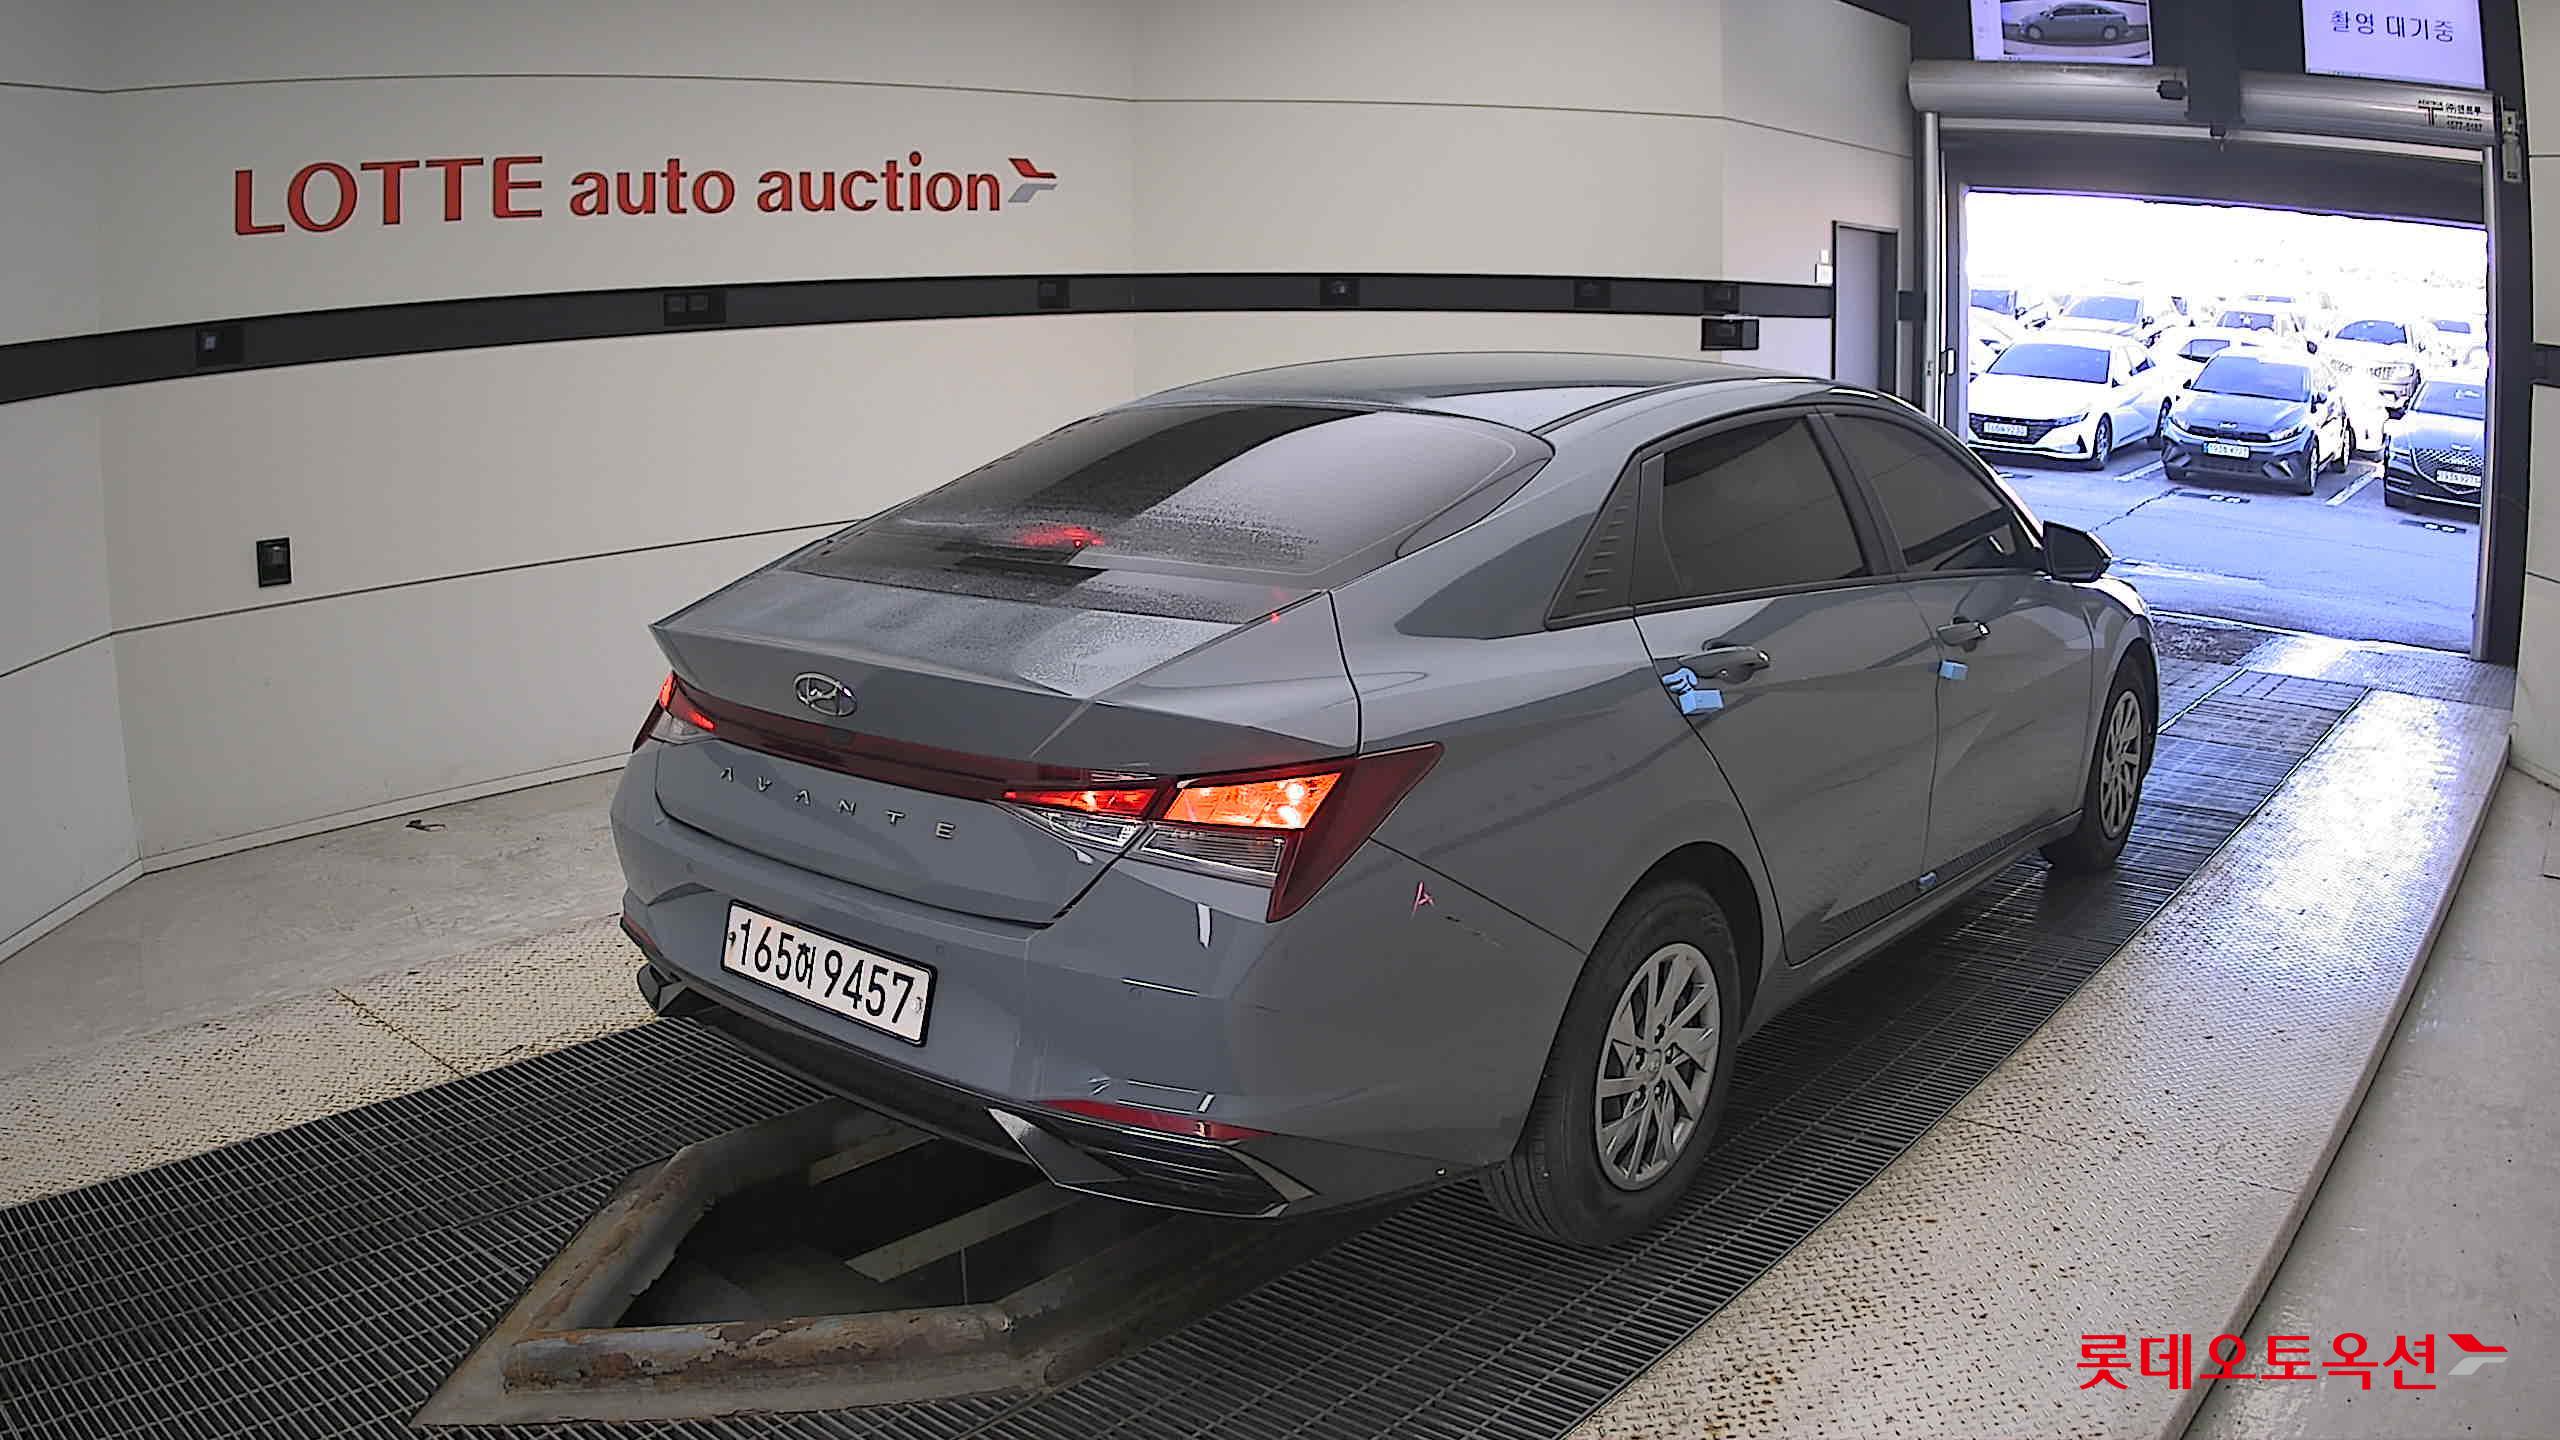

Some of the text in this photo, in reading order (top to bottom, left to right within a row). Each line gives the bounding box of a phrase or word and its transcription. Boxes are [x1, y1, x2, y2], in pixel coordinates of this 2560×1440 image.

[2330, 10, 2454, 43] 촬영 대기중
[234, 151, 1001, 236] LOTTE auto auction
[719, 767, 956, 839] AVANTE
[740, 919, 916, 1025] 165허 9457
